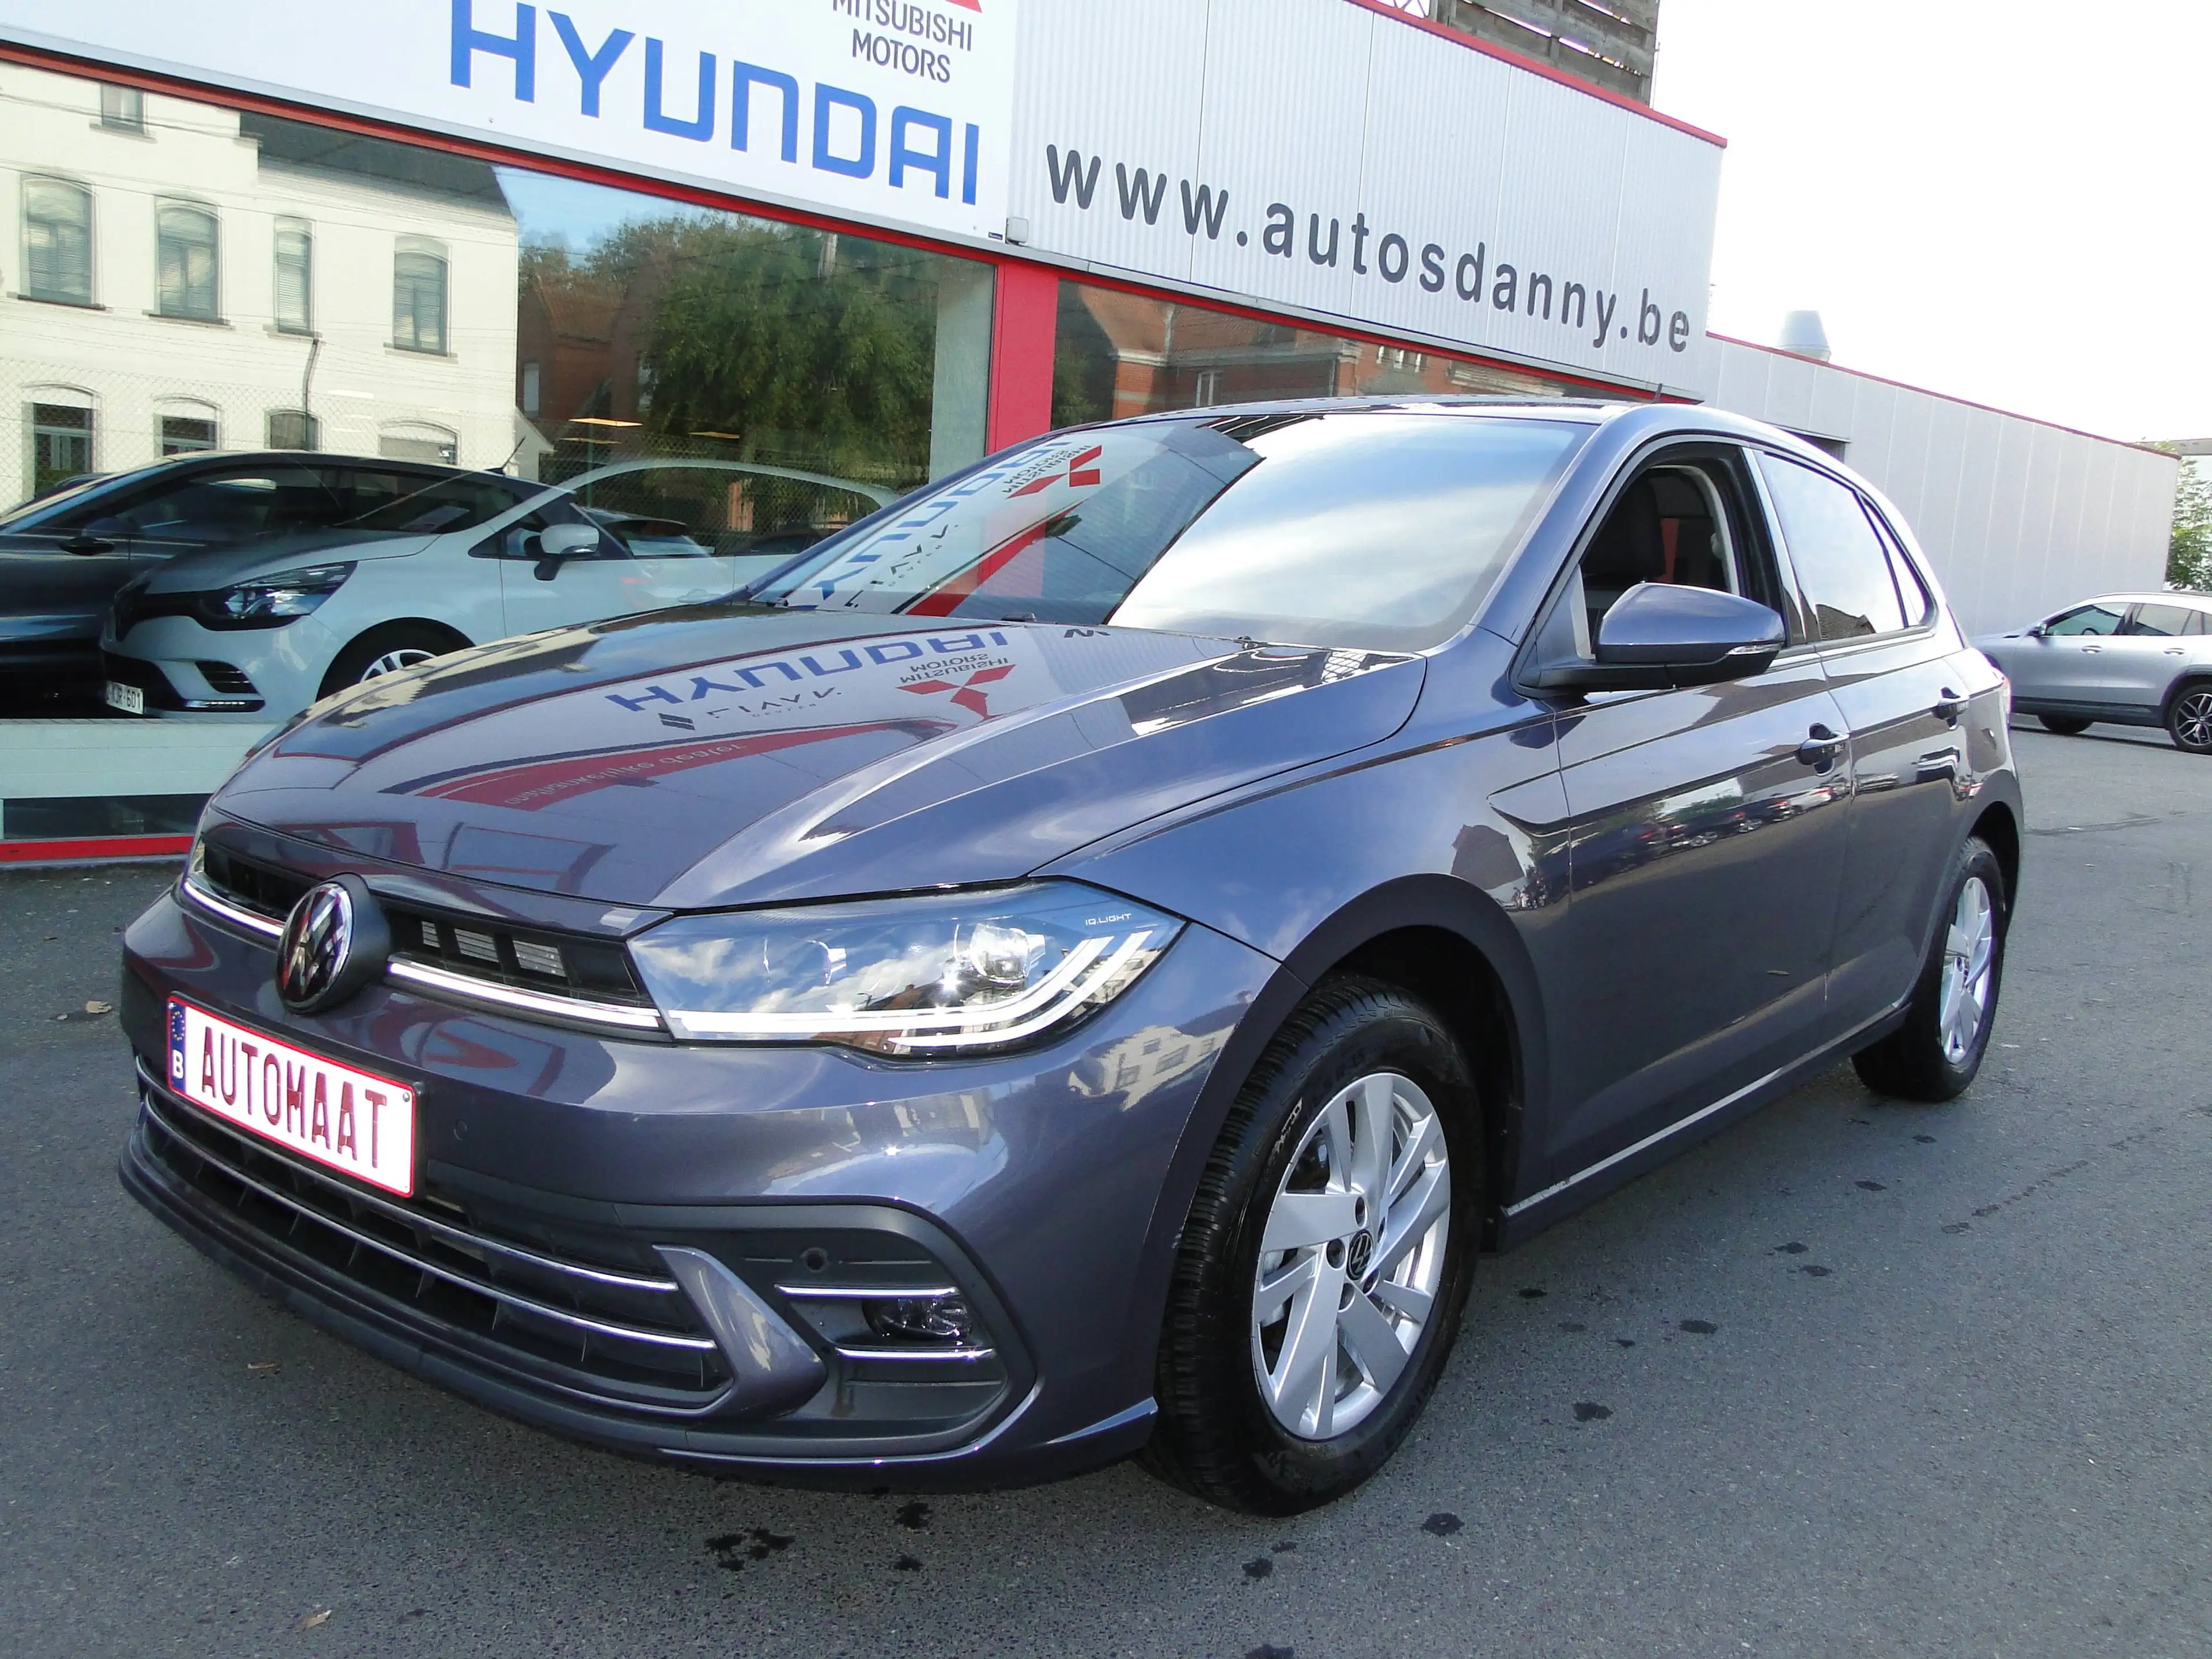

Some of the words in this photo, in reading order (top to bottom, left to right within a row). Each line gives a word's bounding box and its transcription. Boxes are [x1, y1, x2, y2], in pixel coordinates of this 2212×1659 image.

[451, 0, 979, 204] HYUNDAI
[853, 28, 950, 83] MOTORS
[1046, 144, 1691, 353] www.autosdanny.be
[172, 1048, 184, 1080] B
[202, 1027, 387, 1169] AUTOMAAT
